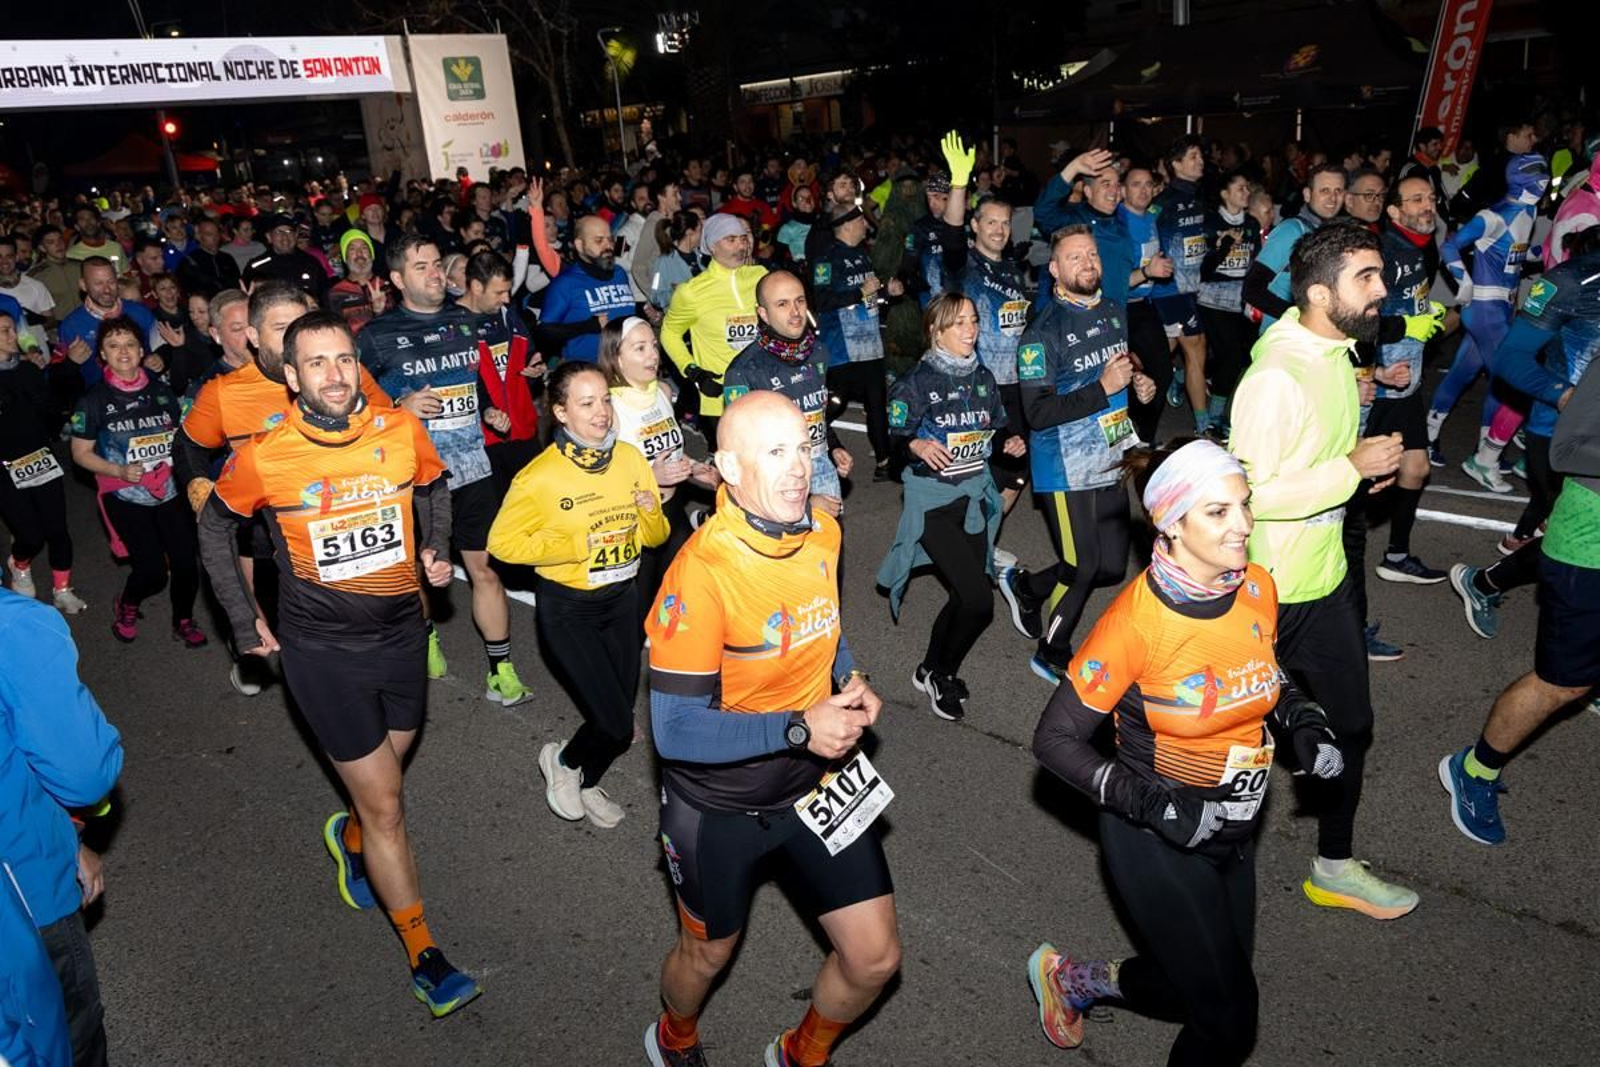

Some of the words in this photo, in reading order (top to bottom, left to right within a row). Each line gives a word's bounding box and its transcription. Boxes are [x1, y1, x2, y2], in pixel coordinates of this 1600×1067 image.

[69, 60, 221, 87] INTERNACIONAL
[223, 59, 277, 82] NOCHE
[278, 58, 301, 80] DE
[302, 56, 333, 79] SAN
[444, 110, 495, 123] calderón
[402, 357, 438, 376] SAN
[1073, 353, 1101, 373] SAN
[107, 416, 135, 433] SAN
[643, 428, 680, 455] 5370
[15, 456, 53, 480] 6029
[323, 523, 395, 557] 5163
[807, 758, 867, 826] 5107
